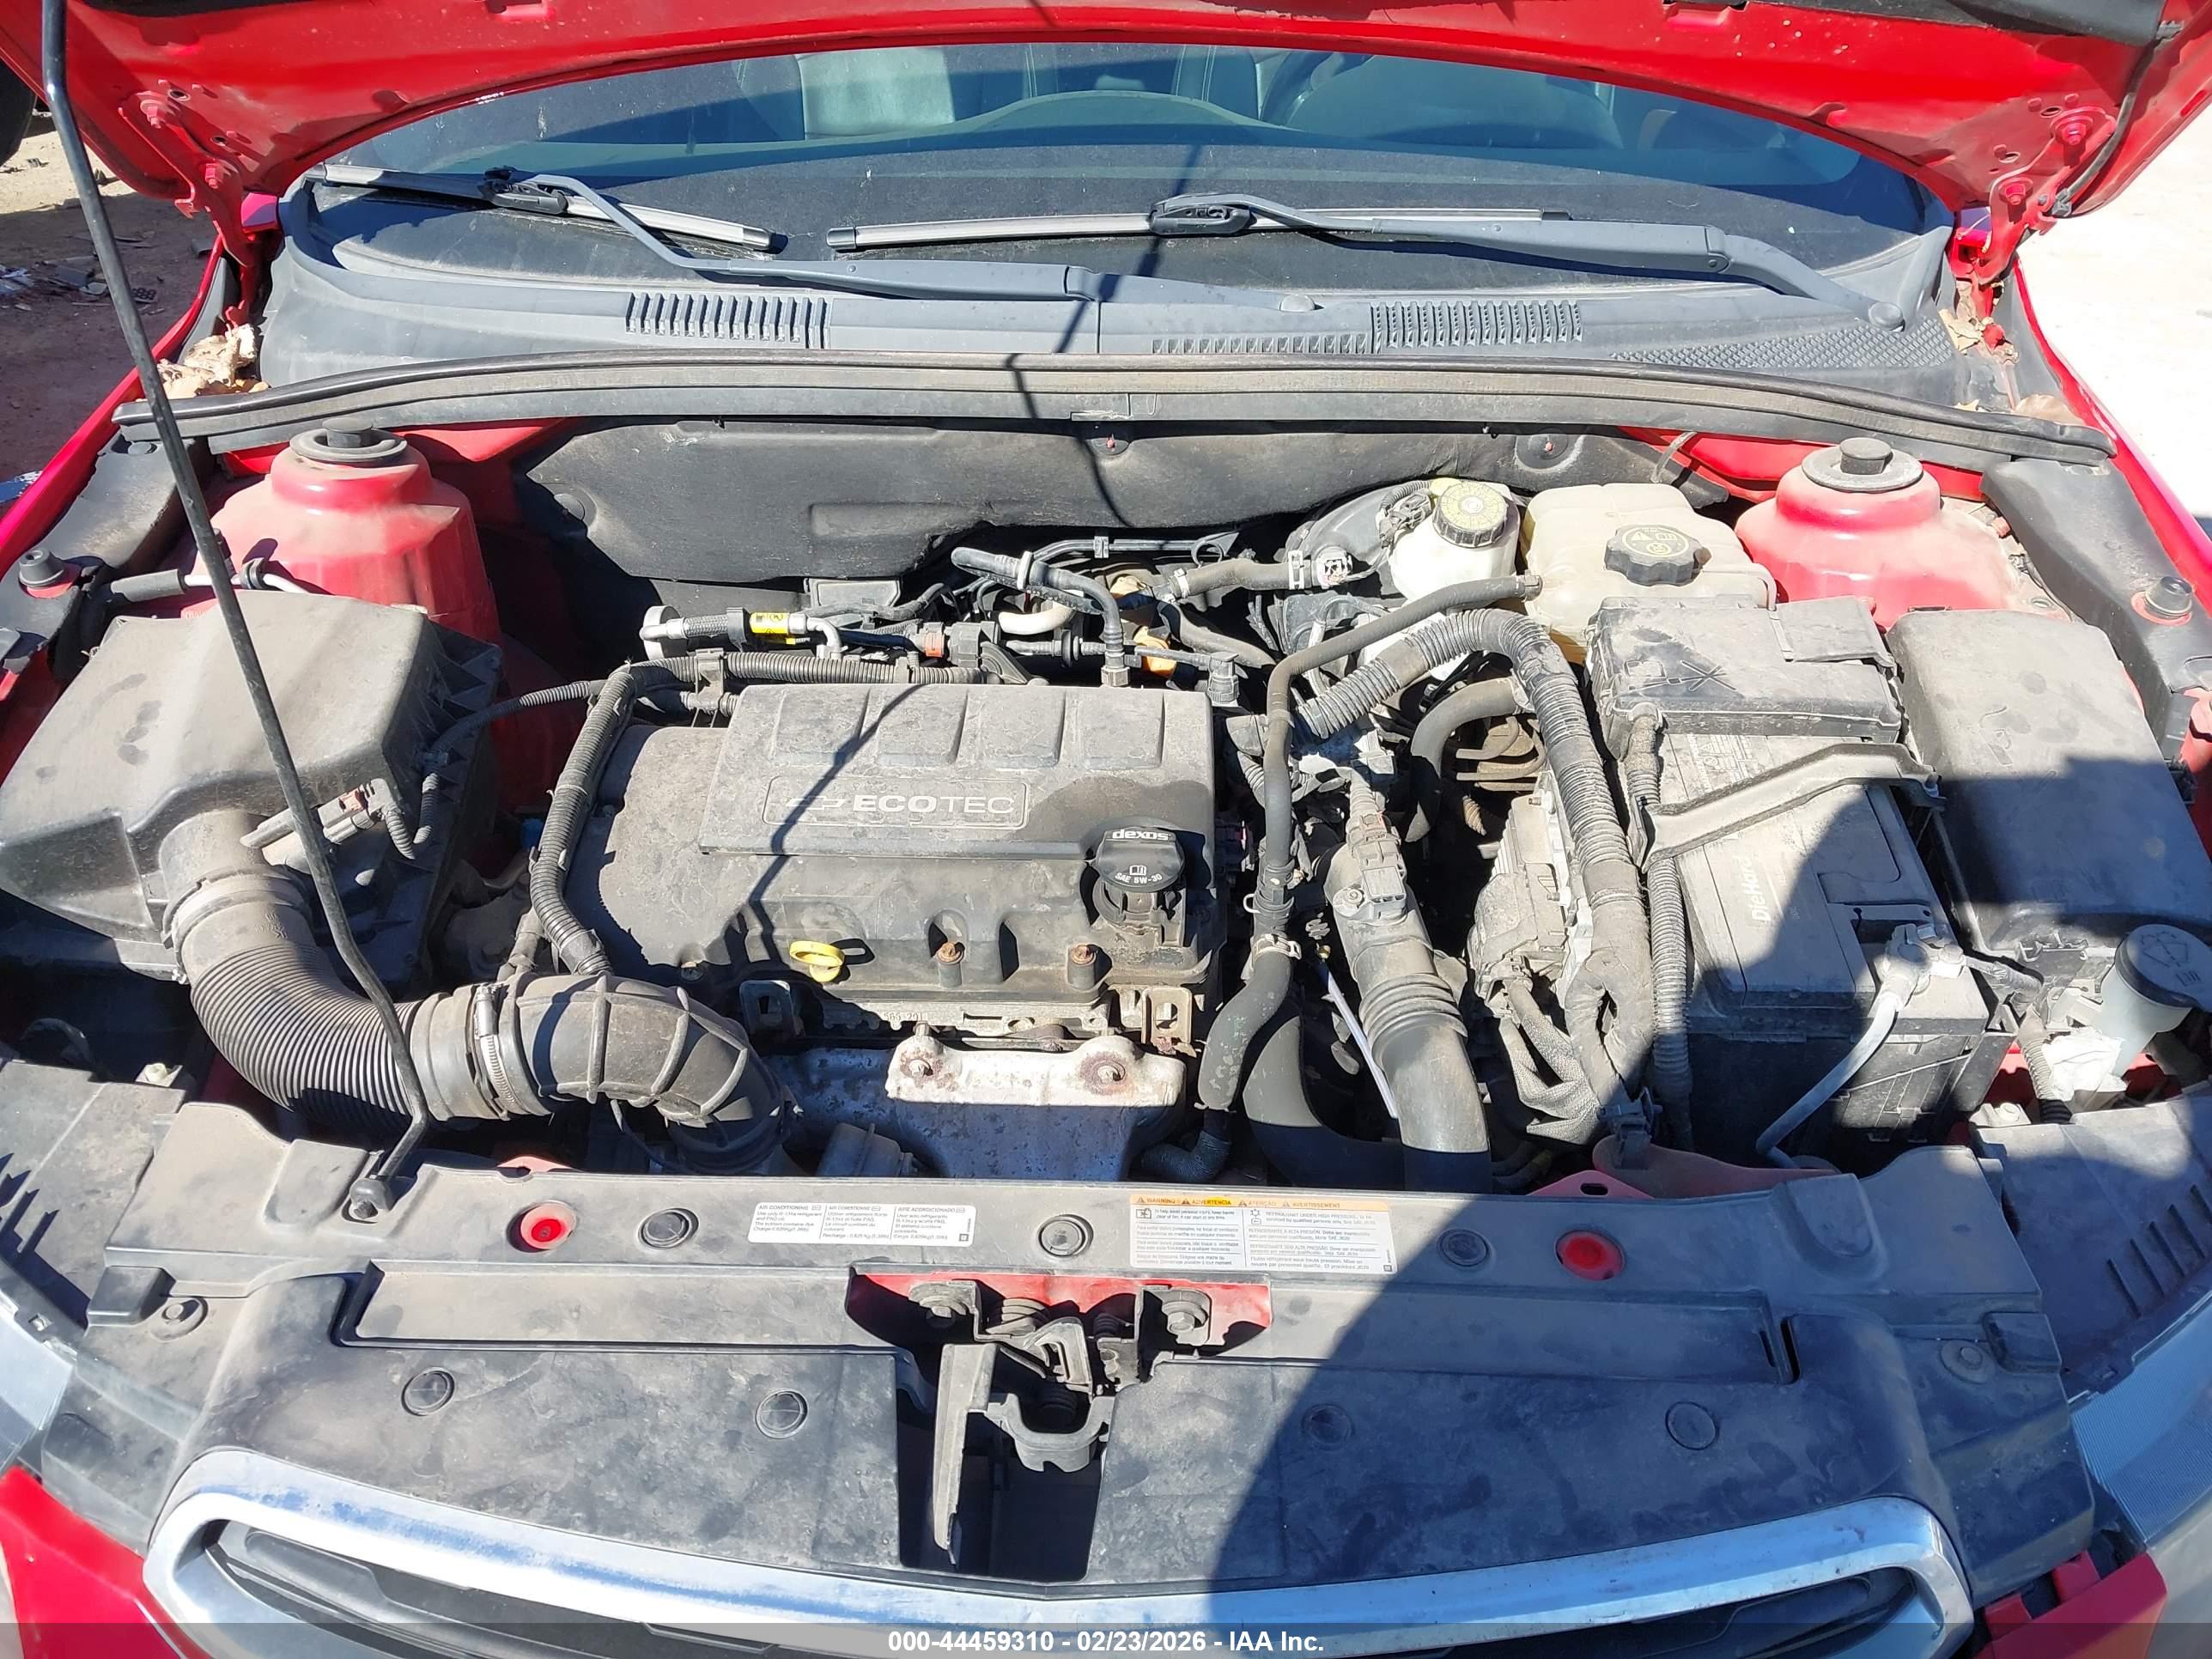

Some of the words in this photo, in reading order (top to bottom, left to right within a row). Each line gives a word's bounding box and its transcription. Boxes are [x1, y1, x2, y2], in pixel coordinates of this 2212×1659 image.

[853, 793, 1014, 815] ECOTEC
[1112, 828, 1169, 841] dexos
[1115, 872, 1132, 884] SAE
[1133, 873, 1163, 884] 5W-30
[1734, 856, 1771, 921] DieHard
